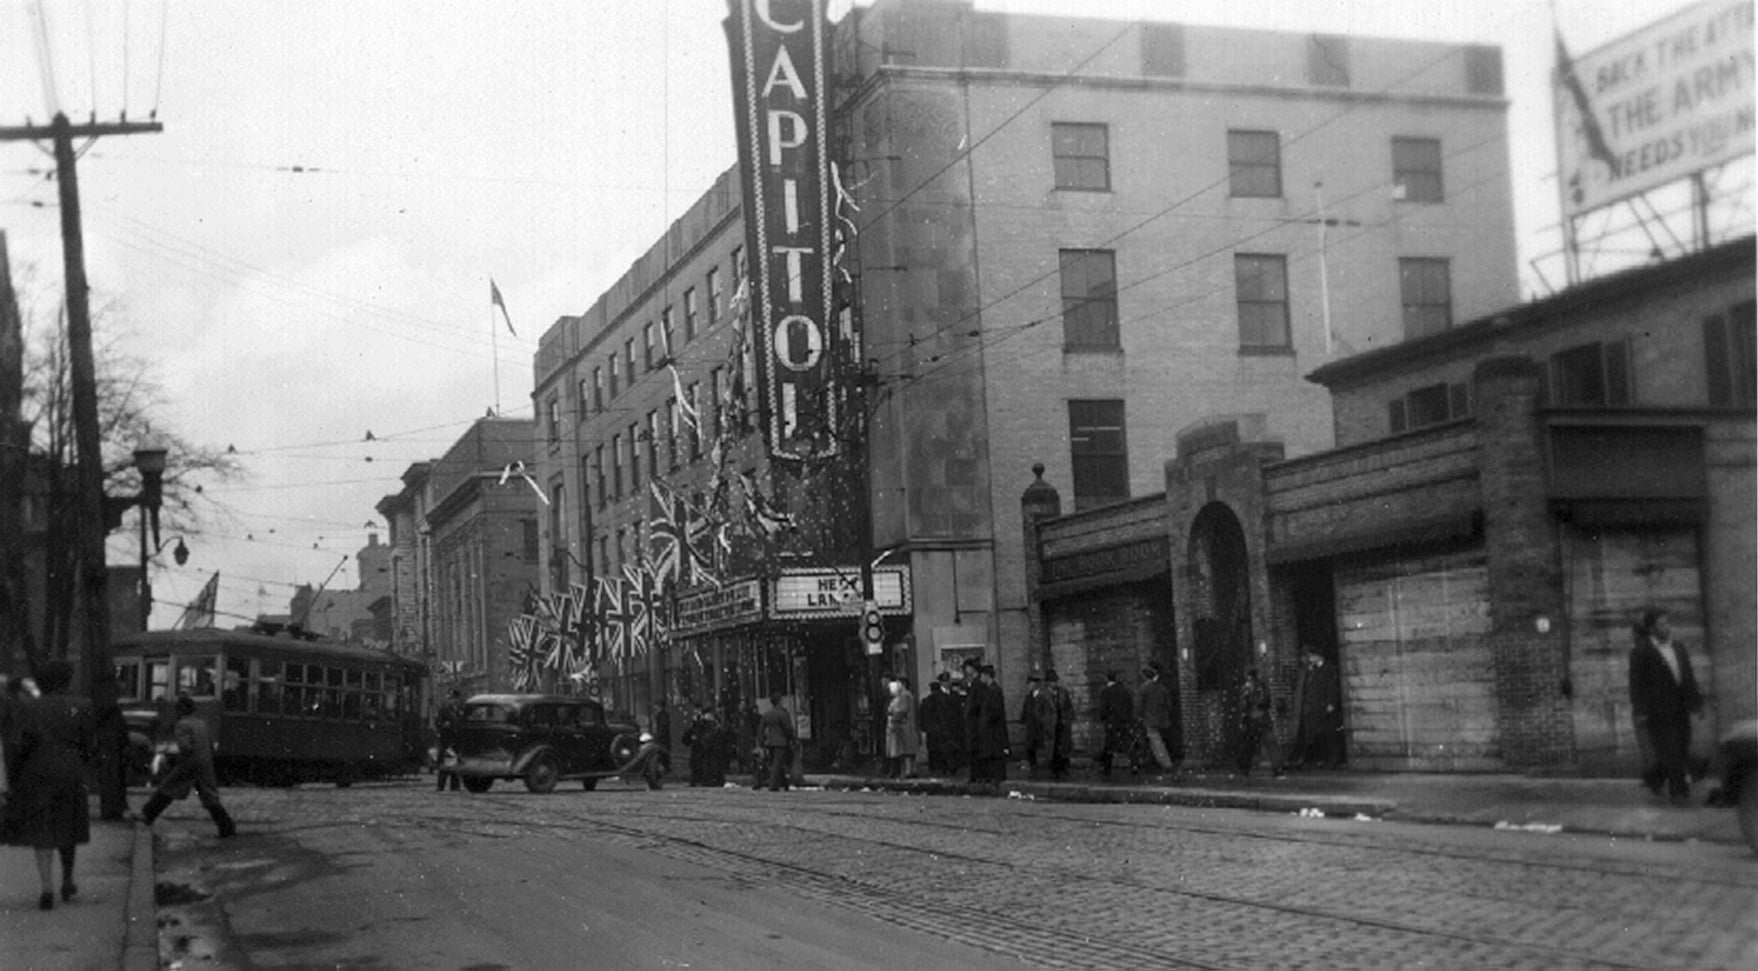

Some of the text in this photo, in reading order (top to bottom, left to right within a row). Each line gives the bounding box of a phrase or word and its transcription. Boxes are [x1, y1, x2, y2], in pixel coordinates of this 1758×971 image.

[1656, 26, 1698, 66] THE
[1607, 86, 1662, 139] THE
[1609, 131, 1684, 182] NEEDS
